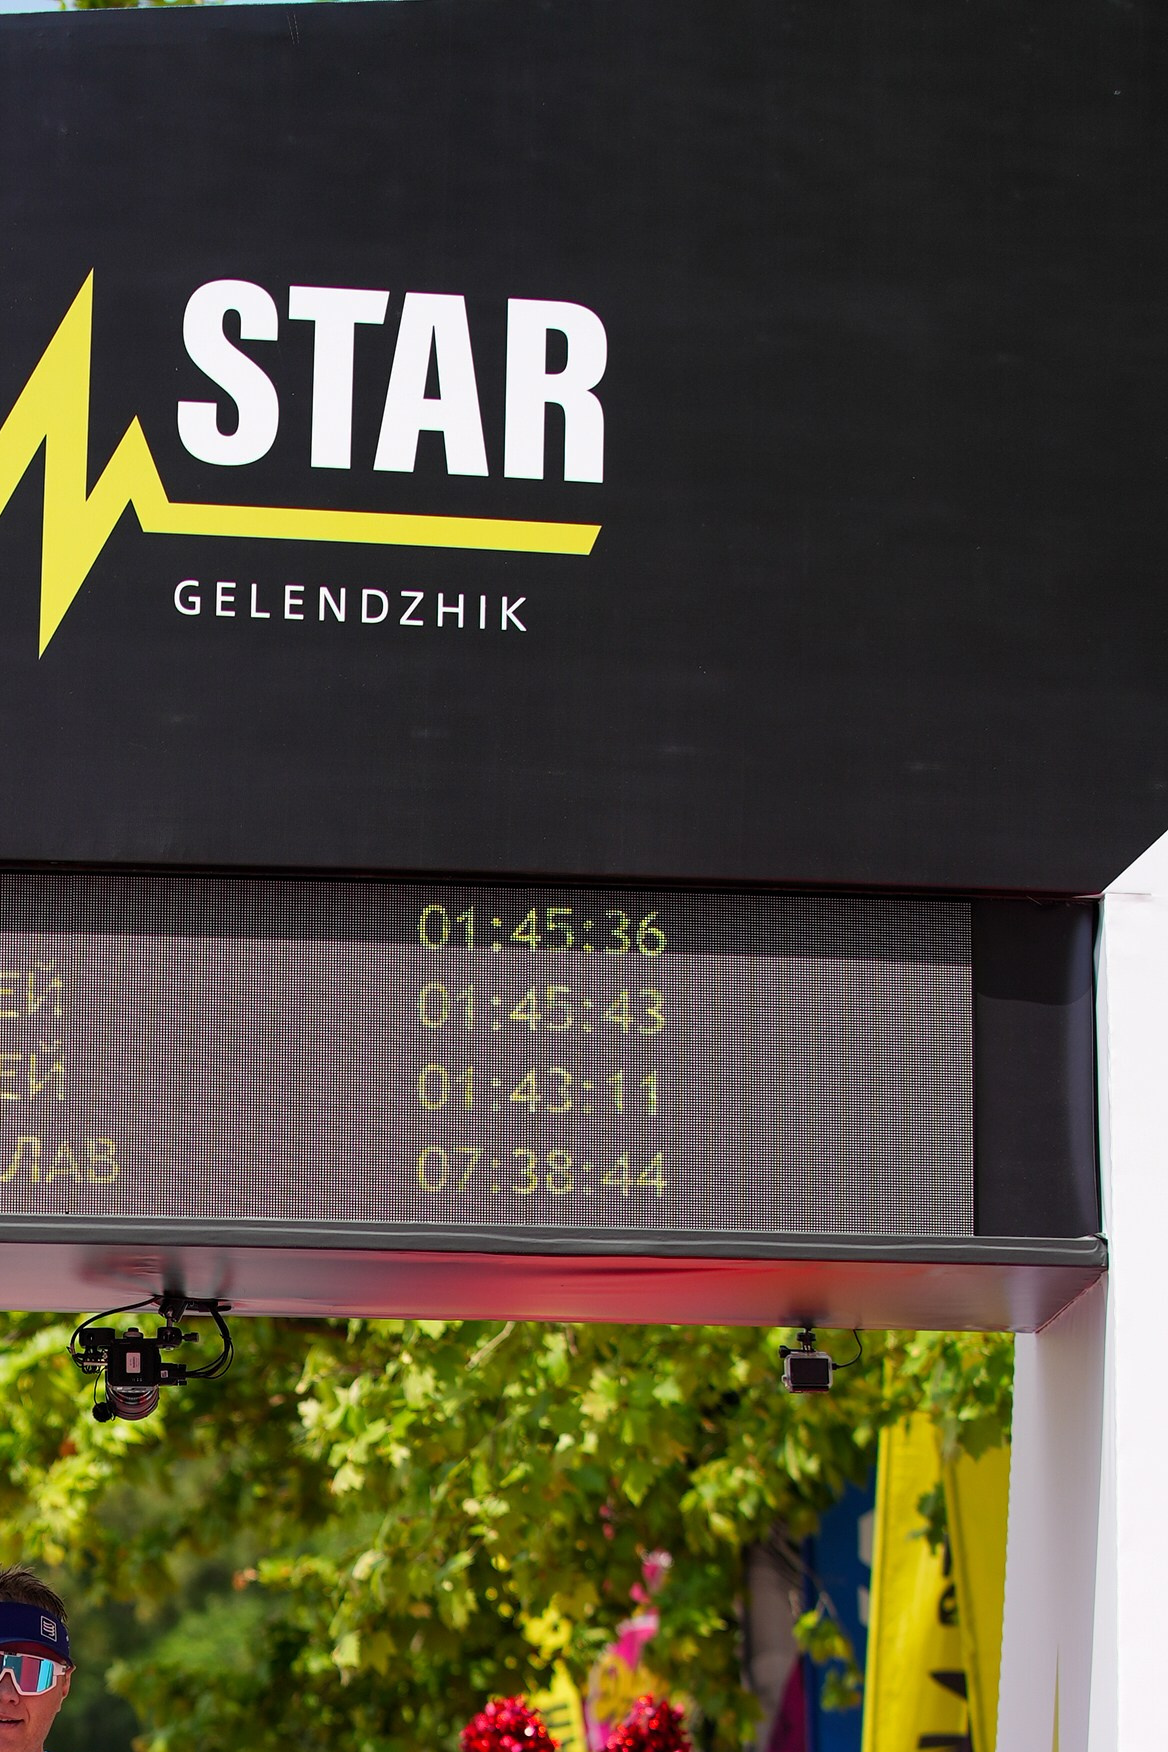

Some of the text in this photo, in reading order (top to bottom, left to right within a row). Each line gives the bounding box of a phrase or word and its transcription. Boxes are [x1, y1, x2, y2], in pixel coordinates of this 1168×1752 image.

[175, 277, 609, 484] STAR
[172, 578, 530, 633] GELENDZHIK
[418, 905, 668, 958] 01:45:36
[418, 982, 667, 1035] 01:45:43
[418, 1063, 659, 1114] 01:43:11
[417, 1145, 666, 1197] 07:38:44
